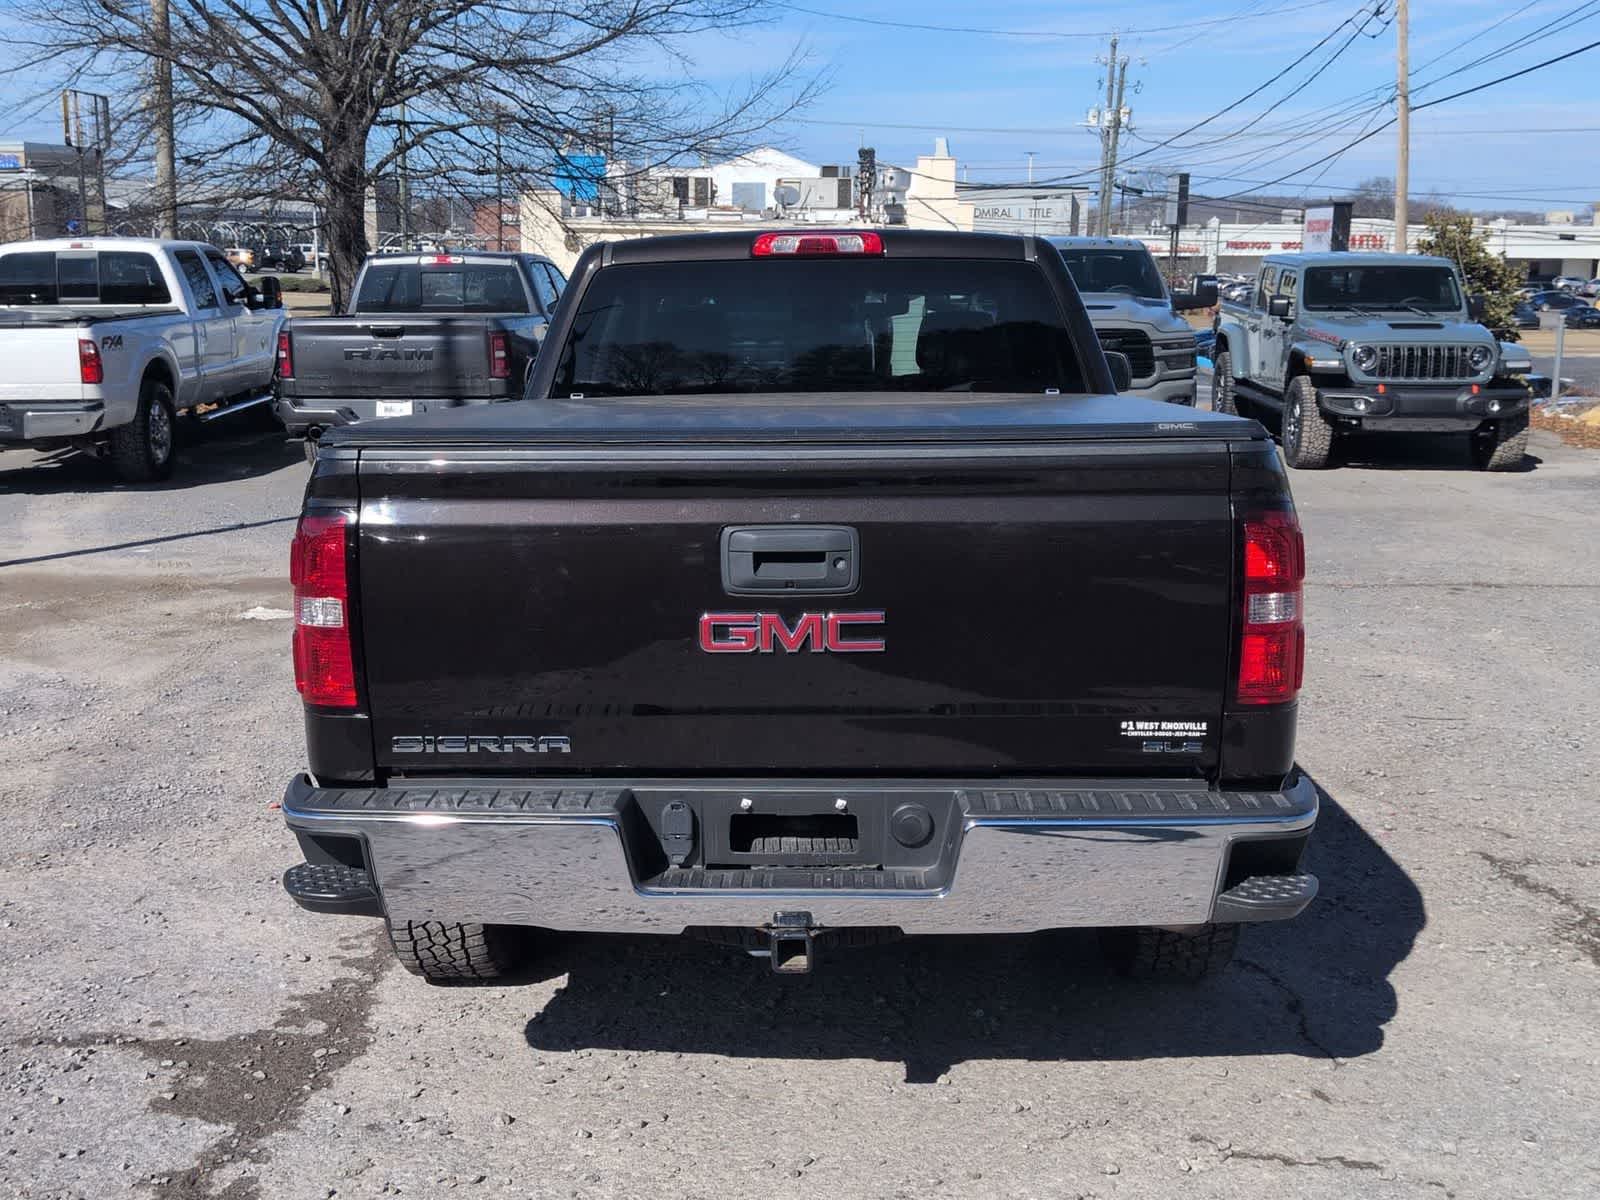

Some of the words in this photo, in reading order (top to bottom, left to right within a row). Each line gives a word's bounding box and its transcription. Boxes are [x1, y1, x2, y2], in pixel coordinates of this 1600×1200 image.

[974, 208, 1012, 218] DMIRAL
[1028, 208, 1052, 218] TITLE
[343, 348, 434, 361] RAM
[1158, 422, 1194, 430] GMC
[700, 612, 886, 654] GMC
[1121, 721, 1134, 730] #1
[1136, 721, 1160, 730] WEST
[1161, 721, 1207, 730] KNOXVILLE
[392, 735, 571, 753] SIERRA
[1142, 741, 1203, 752] SLE
